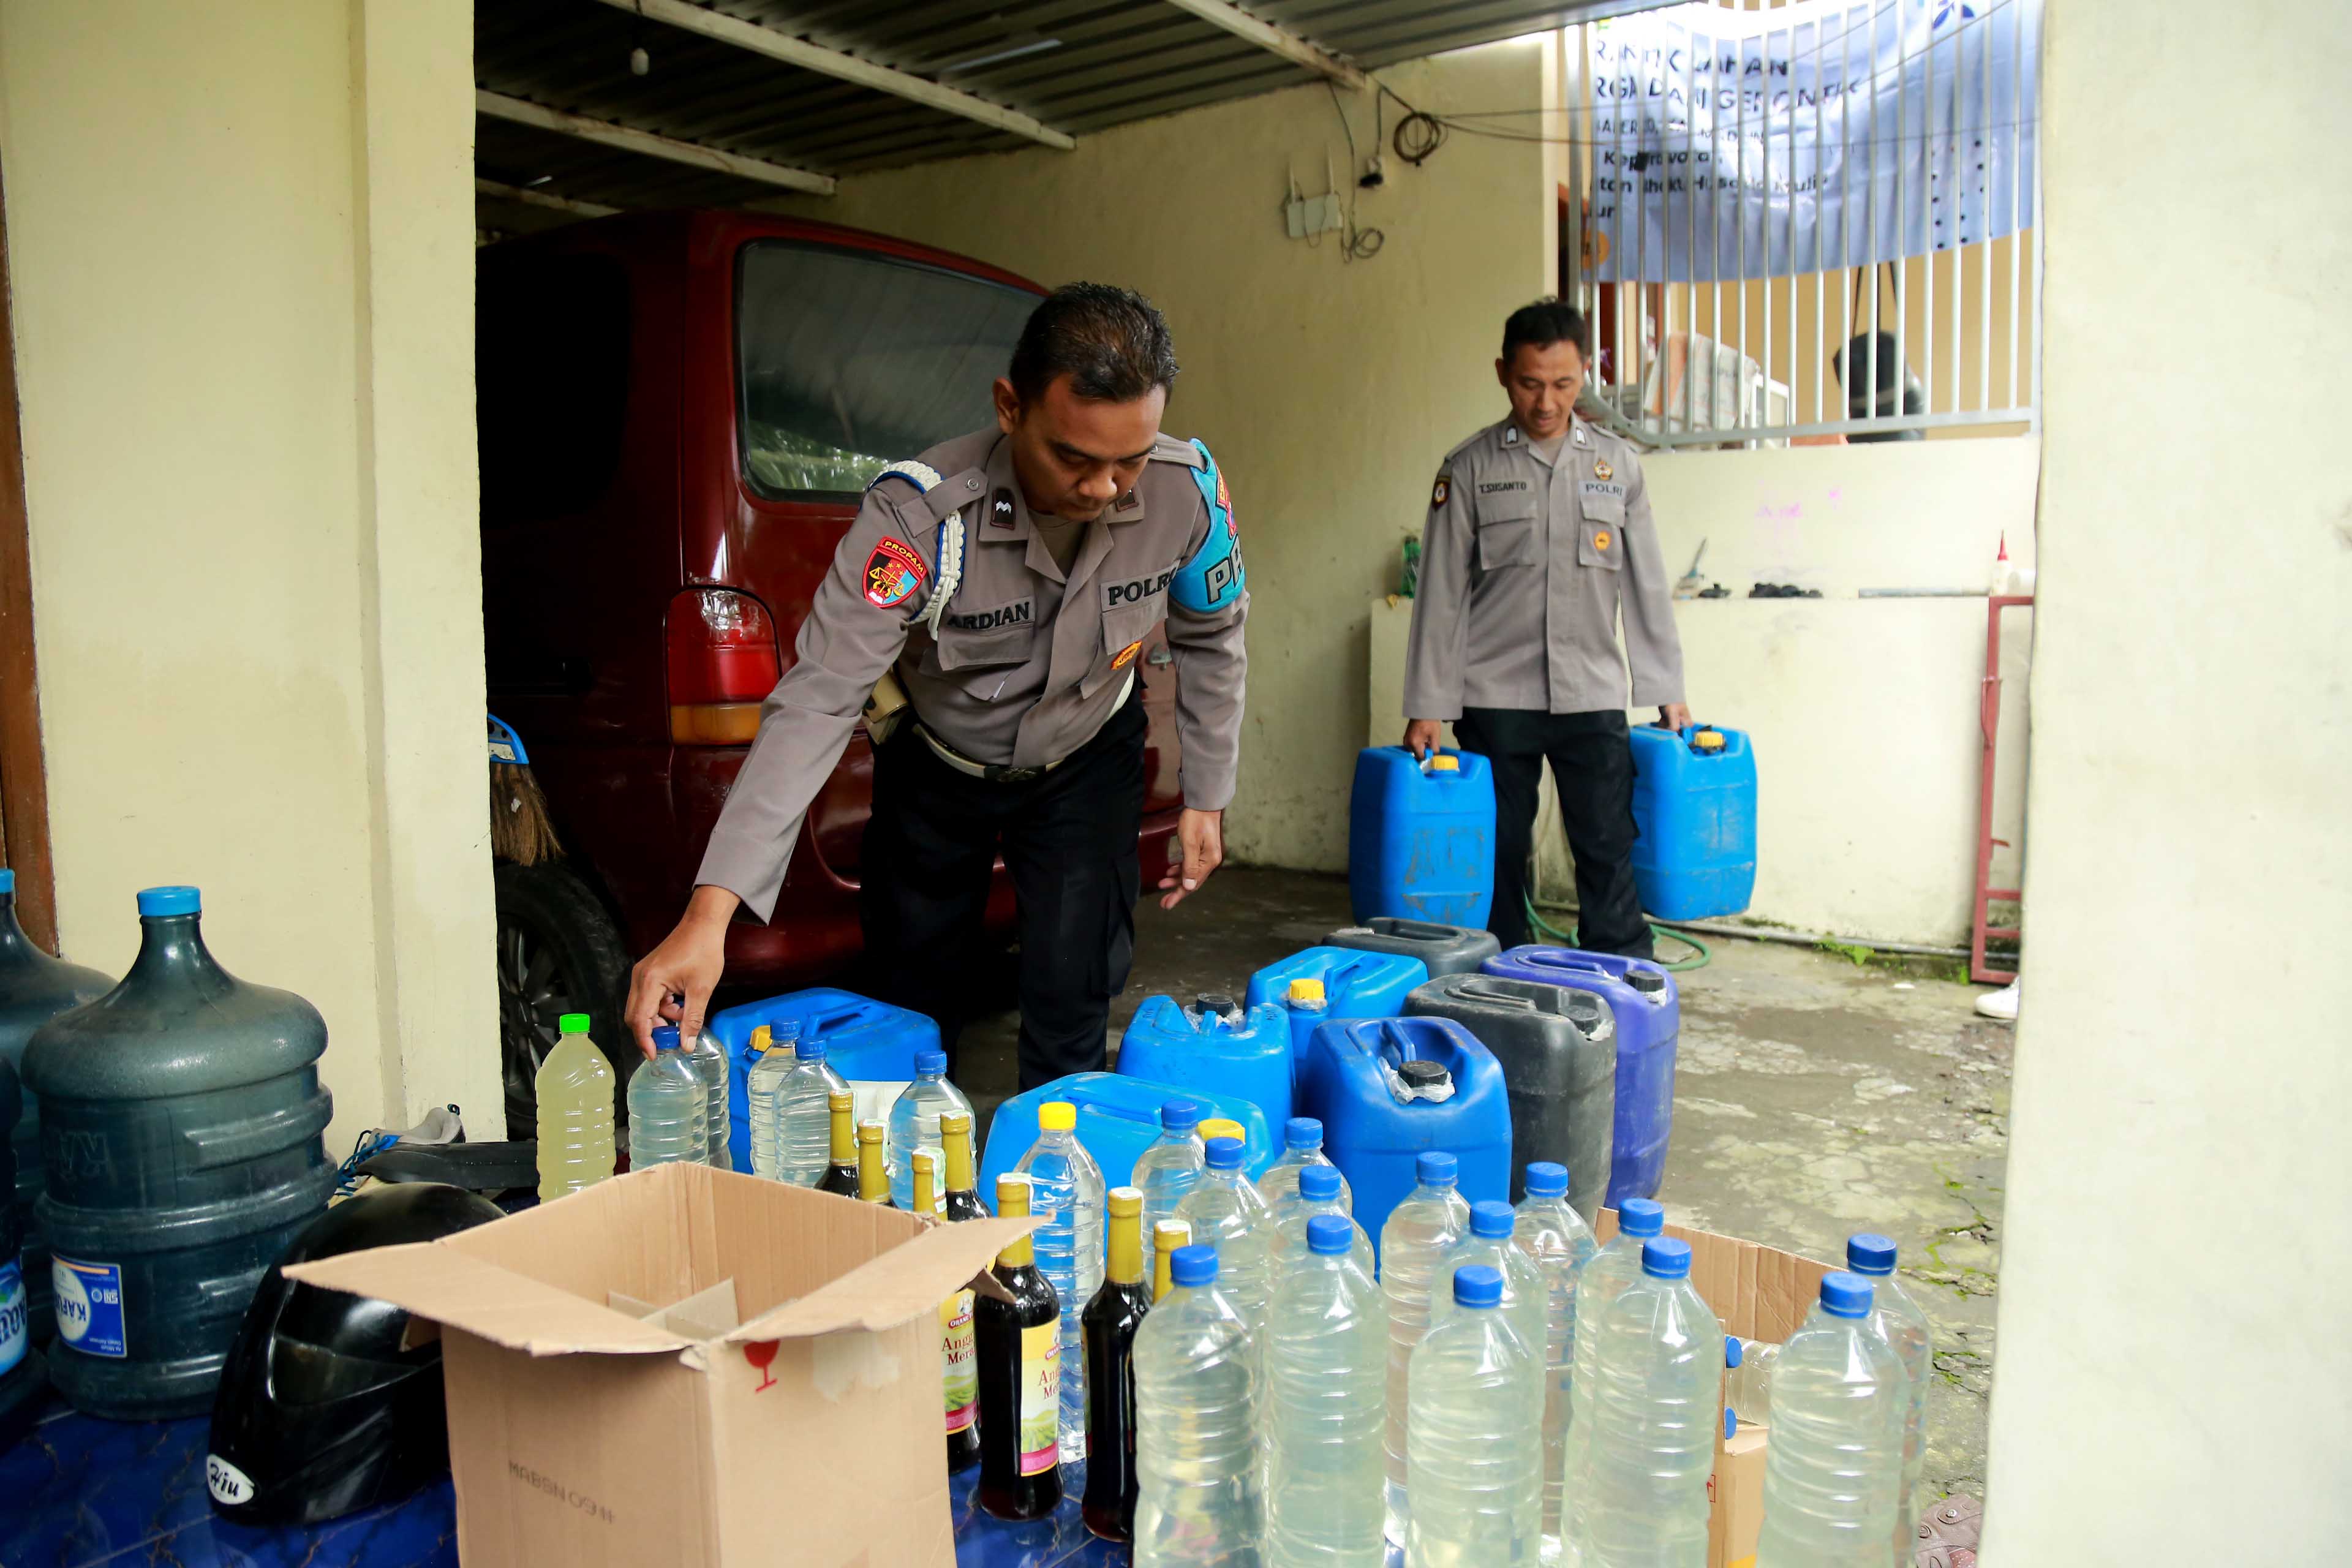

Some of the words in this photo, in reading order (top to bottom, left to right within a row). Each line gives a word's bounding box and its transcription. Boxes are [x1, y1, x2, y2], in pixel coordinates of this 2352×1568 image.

[1479, 481, 1527, 494] T.SUSANTO
[1585, 483, 1623, 496] POLRI
[884, 541, 924, 573] PROPAM
[0, 1295, 26, 1344] AQU
[941, 1333, 974, 1352] Angg
